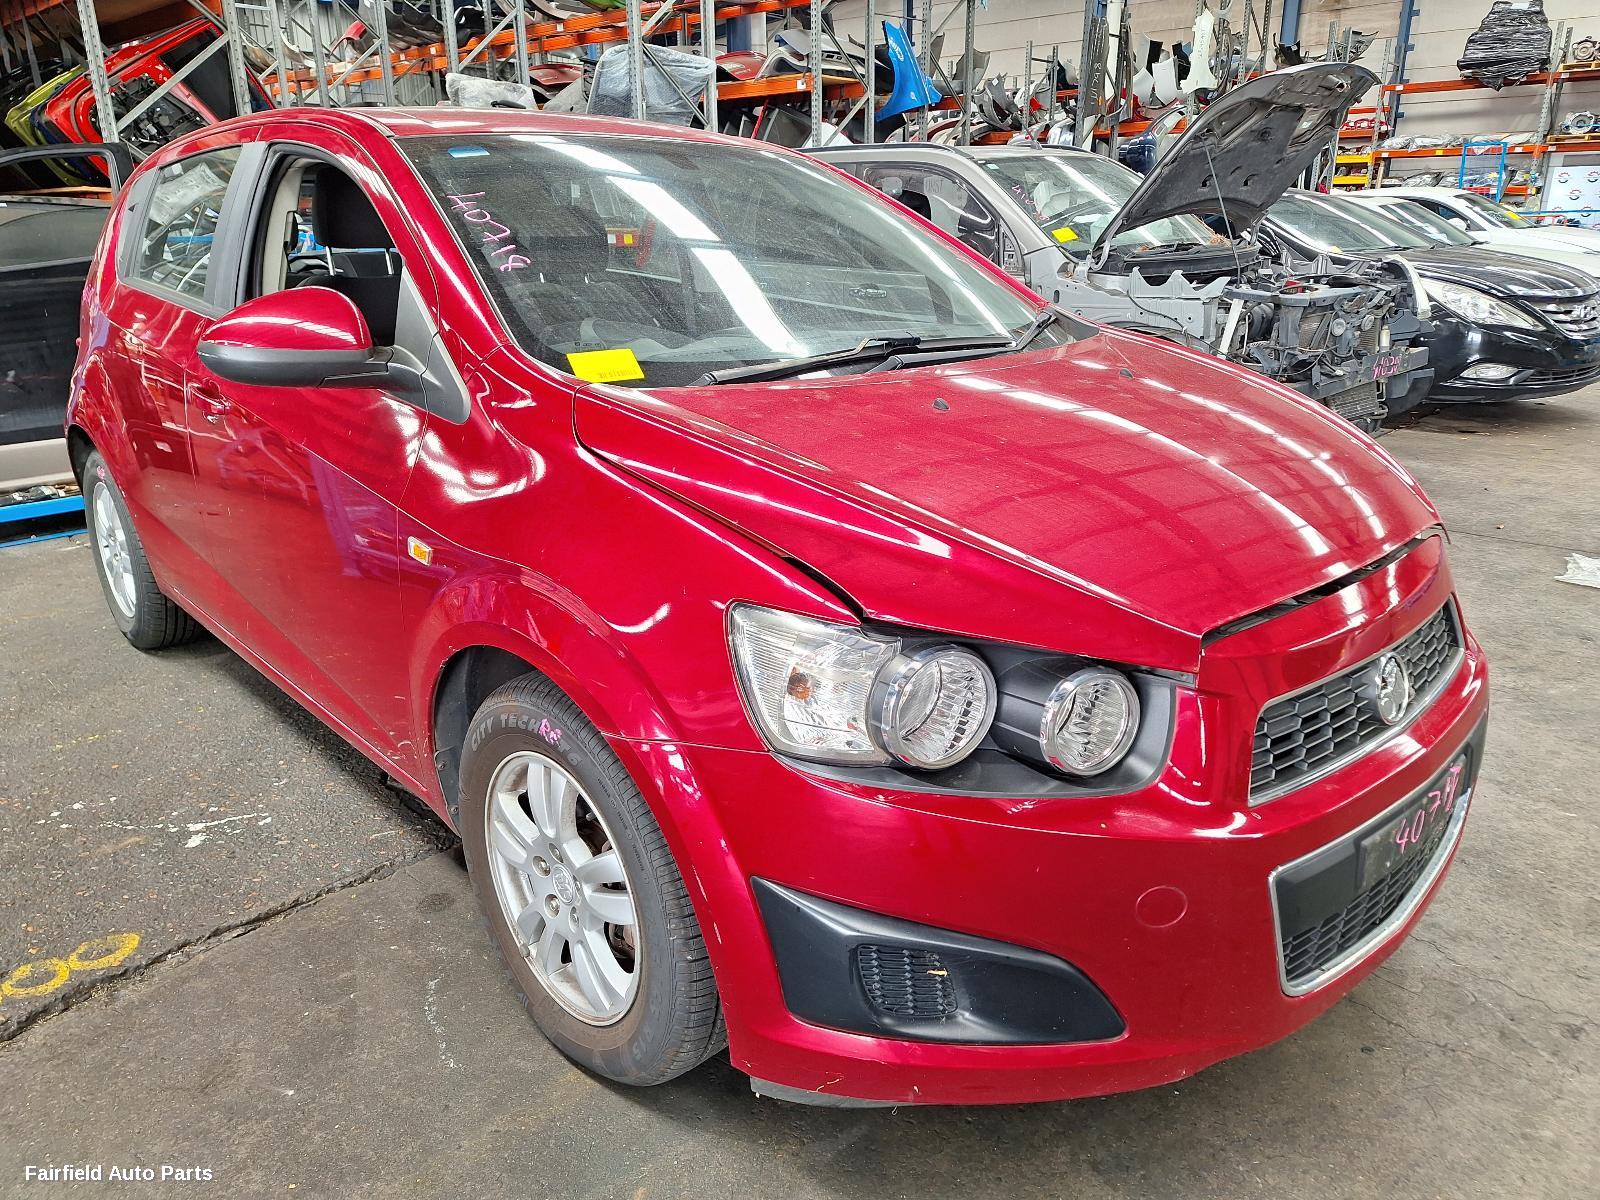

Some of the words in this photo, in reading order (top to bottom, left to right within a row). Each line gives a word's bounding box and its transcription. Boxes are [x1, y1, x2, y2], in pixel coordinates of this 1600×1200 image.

[447, 191, 531, 273] 40718
[471, 717, 494, 752] CITY
[500, 712, 541, 734] TECH
